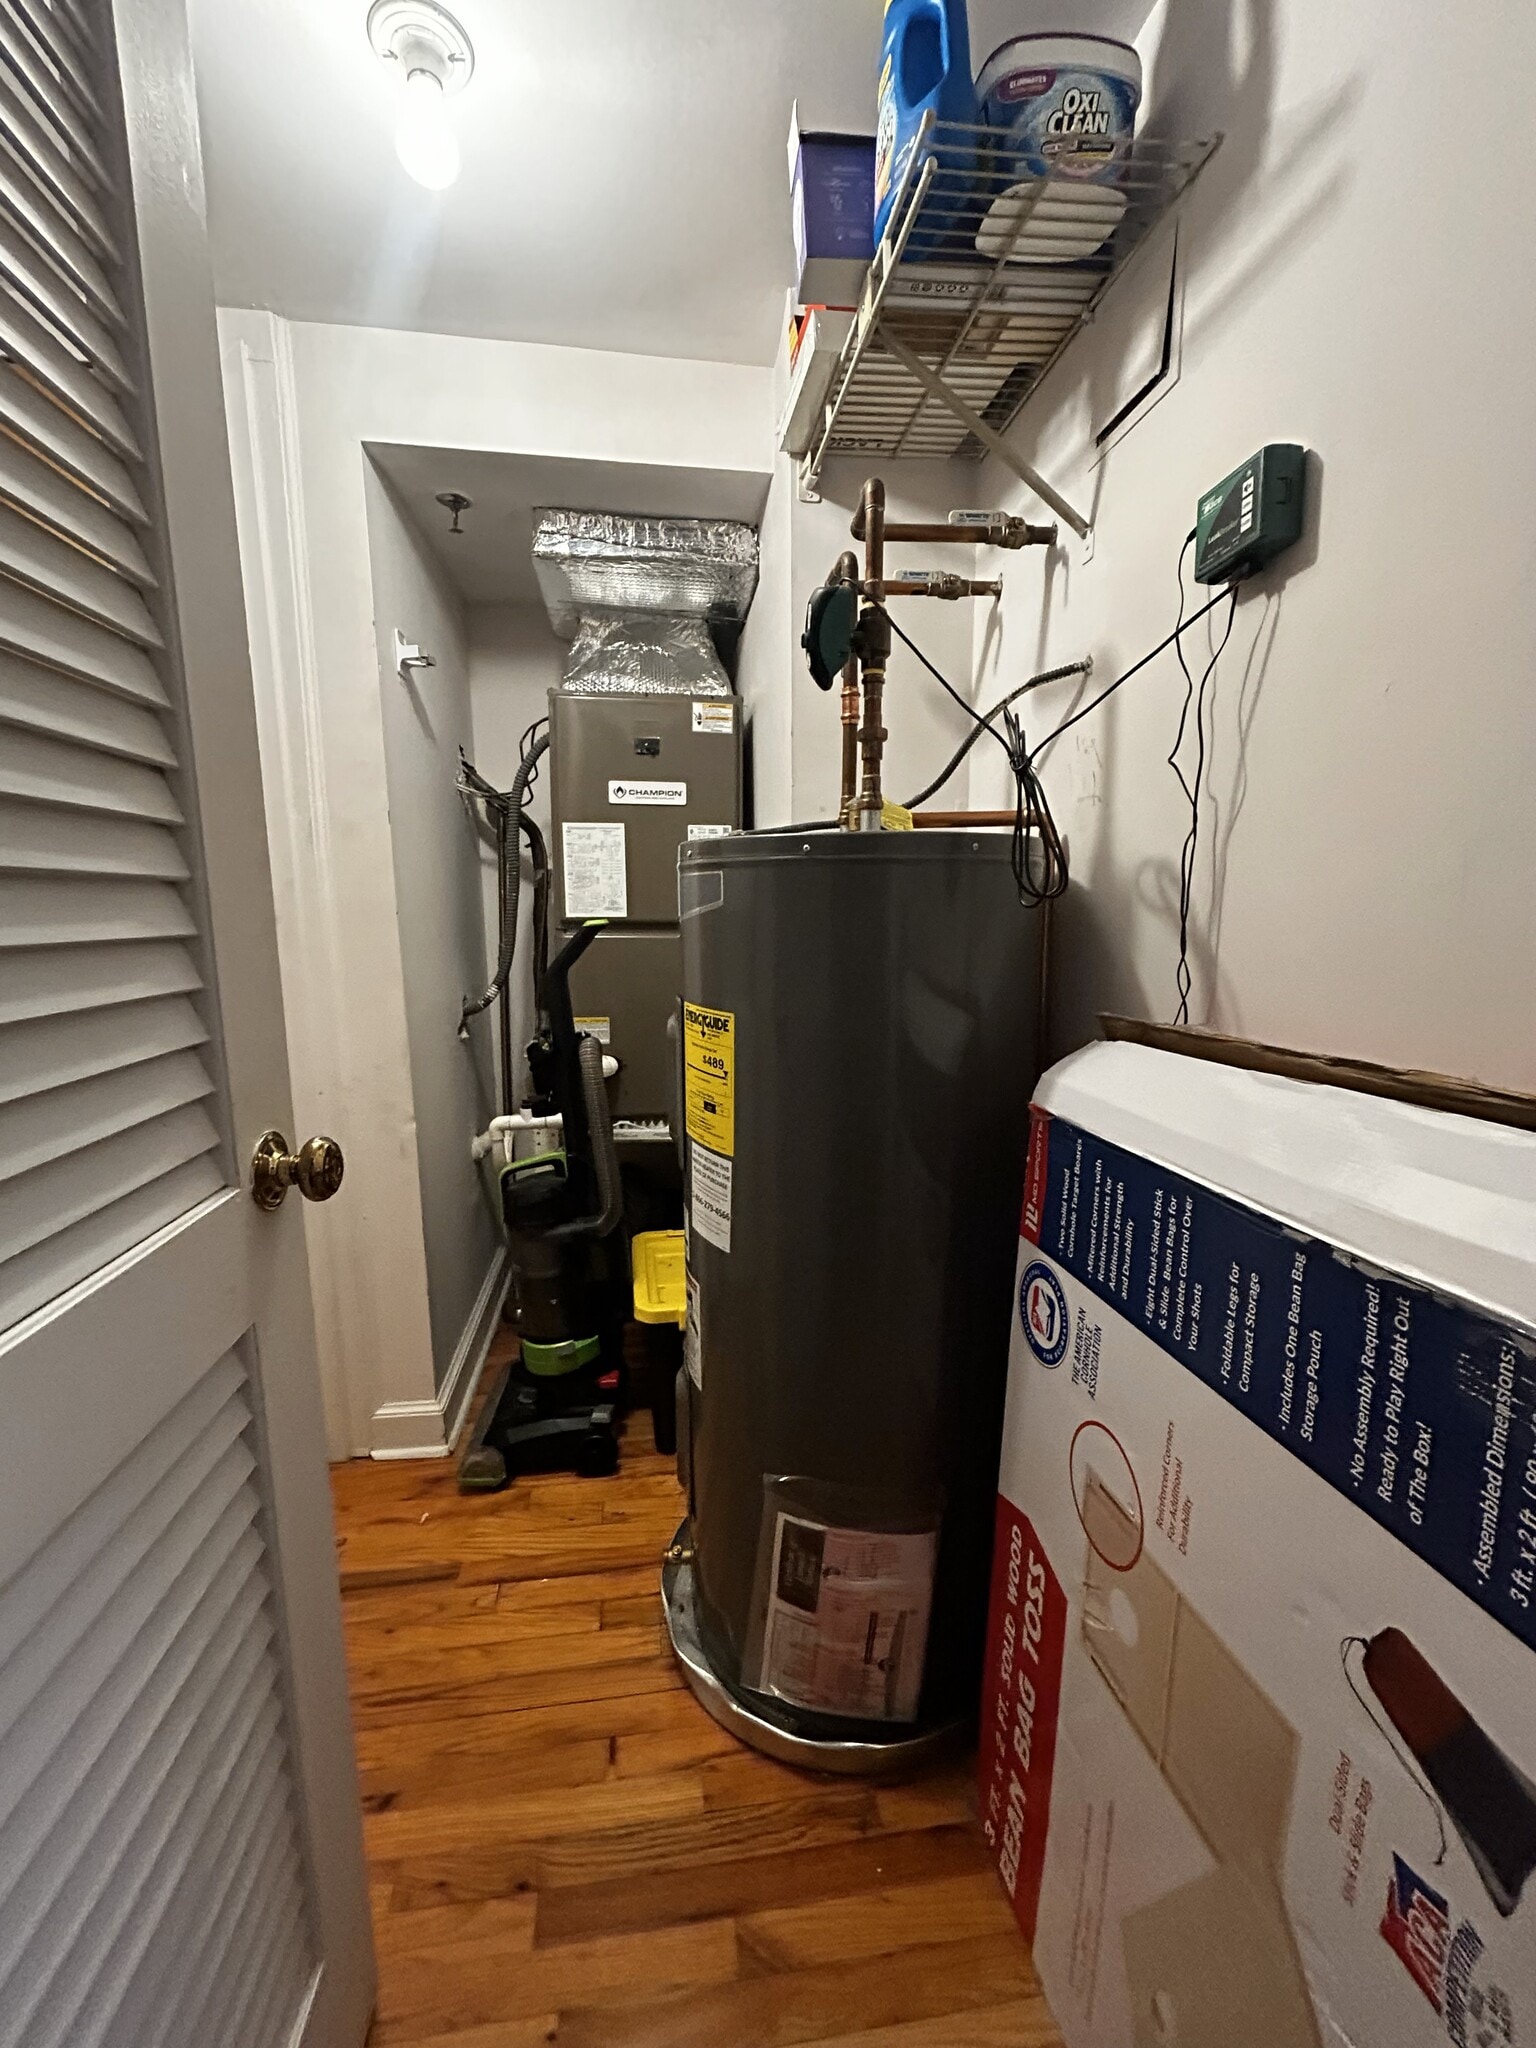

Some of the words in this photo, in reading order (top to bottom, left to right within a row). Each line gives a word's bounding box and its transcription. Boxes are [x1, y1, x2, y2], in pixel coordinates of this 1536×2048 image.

[1062, 87, 1101, 114] OXI
[1046, 108, 1109, 135] CLEAN
[628, 789, 683, 797] CHAMPION
[702, 1054, 725, 1071] $489
[1073, 1138, 1083, 1178] Boards
[1094, 1159, 1103, 1185] with
[1062, 1168, 1071, 1199] Wood
[1071, 1178, 1080, 1210] Target
[1153, 1188, 1164, 1218] Stick
[1060, 1199, 1070, 1227] Solid
[1090, 1187, 1101, 1228] Corners
[1113, 1181, 1125, 1232] Strength
[1170, 1195, 1178, 1216] for
[1182, 1195, 1193, 1228] Over
[1057, 1229, 1066, 1249] Two
[1067, 1211, 1078, 1258] Cornhole
[1097, 1196, 1111, 1283] Reinforcements
[1104, 1176, 1113, 1194] for
[1122, 1218, 1136, 1277] Durability
[1166, 1217, 1177, 1249] Bags
[1087, 1228, 1097, 1274] Mitered
[1107, 1232, 1121, 1292] Additional
[1148, 1220, 1161, 1287] Dual-Sided
[1163, 1249, 1174, 1281] Bean
[1178, 1228, 1190, 1279] Control
[1291, 1252, 1307, 1283] Bag
[1229, 1261, 1241, 1285] for
[1144, 1286, 1156, 1319] Eight
[1160, 1285, 1170, 1318] Slide
[1173, 1280, 1187, 1342] Complete
[1191, 1282, 1203, 1320] Shots
[1226, 1284, 1240, 1318] Legs
[1244, 1272, 1260, 1329] Storage
[1287, 1285, 1302, 1325] Bean
[1393, 1296, 1411, 1332] Out
[1075, 1306, 1087, 1368] AMERICAN
[1158, 1319, 1168, 1330] &
[1188, 1319, 1200, 1352] Your
[1284, 1325, 1299, 1359] One
[1360, 1283, 1381, 1370] Required!
[1080, 1324, 1093, 1384] CORNHOLE
[1087, 1324, 1103, 1401] ASSOCIATION
[1220, 1318, 1236, 1379] Foldable
[1238, 1329, 1256, 1393] Compact
[1306, 1329, 1322, 1381] Pouch
[1389, 1333, 1409, 1383] Right
[1071, 1367, 1082, 1386] THE
[1278, 1359, 1296, 1424] Includes
[1300, 1381, 1320, 1442] Storage
[1353, 1372, 1376, 1454] Assembly
[1385, 1383, 1406, 1425] Play
[1162, 1419, 1175, 1466] Corners
[1382, 1423, 1399, 1446] to
[1413, 1420, 1433, 1467] Box!
[1350, 1452, 1365, 1482] No
[1377, 1446, 1400, 1503] Ready
[1409, 1467, 1427, 1501] The
[1156, 1464, 1170, 1531] Reinforced
[1170, 1456, 1184, 1522] Additional
[1167, 1518, 1177, 1543] For
[1178, 1495, 1195, 1557] Durability
[1406, 1499, 1423, 1525] of
[1473, 1464, 1502, 1580] Assembled
[1517, 1526, 1536, 1547] 2
[1520, 1545, 1536, 1566] x
[1007, 1524, 1022, 1606] WOOD
[1510, 1566, 1534, 1591] ft.
[1022, 1549, 1046, 1666] TOSS
[1509, 1585, 1529, 1608] 3
[1001, 1612, 1016, 1690] SOLID
[1013, 1668, 1036, 1773] BAG
[1334, 1748, 1351, 1798] Sided
[1354, 1776, 1373, 1817] Bags
[984, 1820, 996, 1847] 3
[999, 1768, 1027, 1900] BEAN
[1328, 1799, 1344, 1836] Dual
[1349, 1812, 1366, 1856] Slide
[1404, 1886, 1451, 2004] ACA
